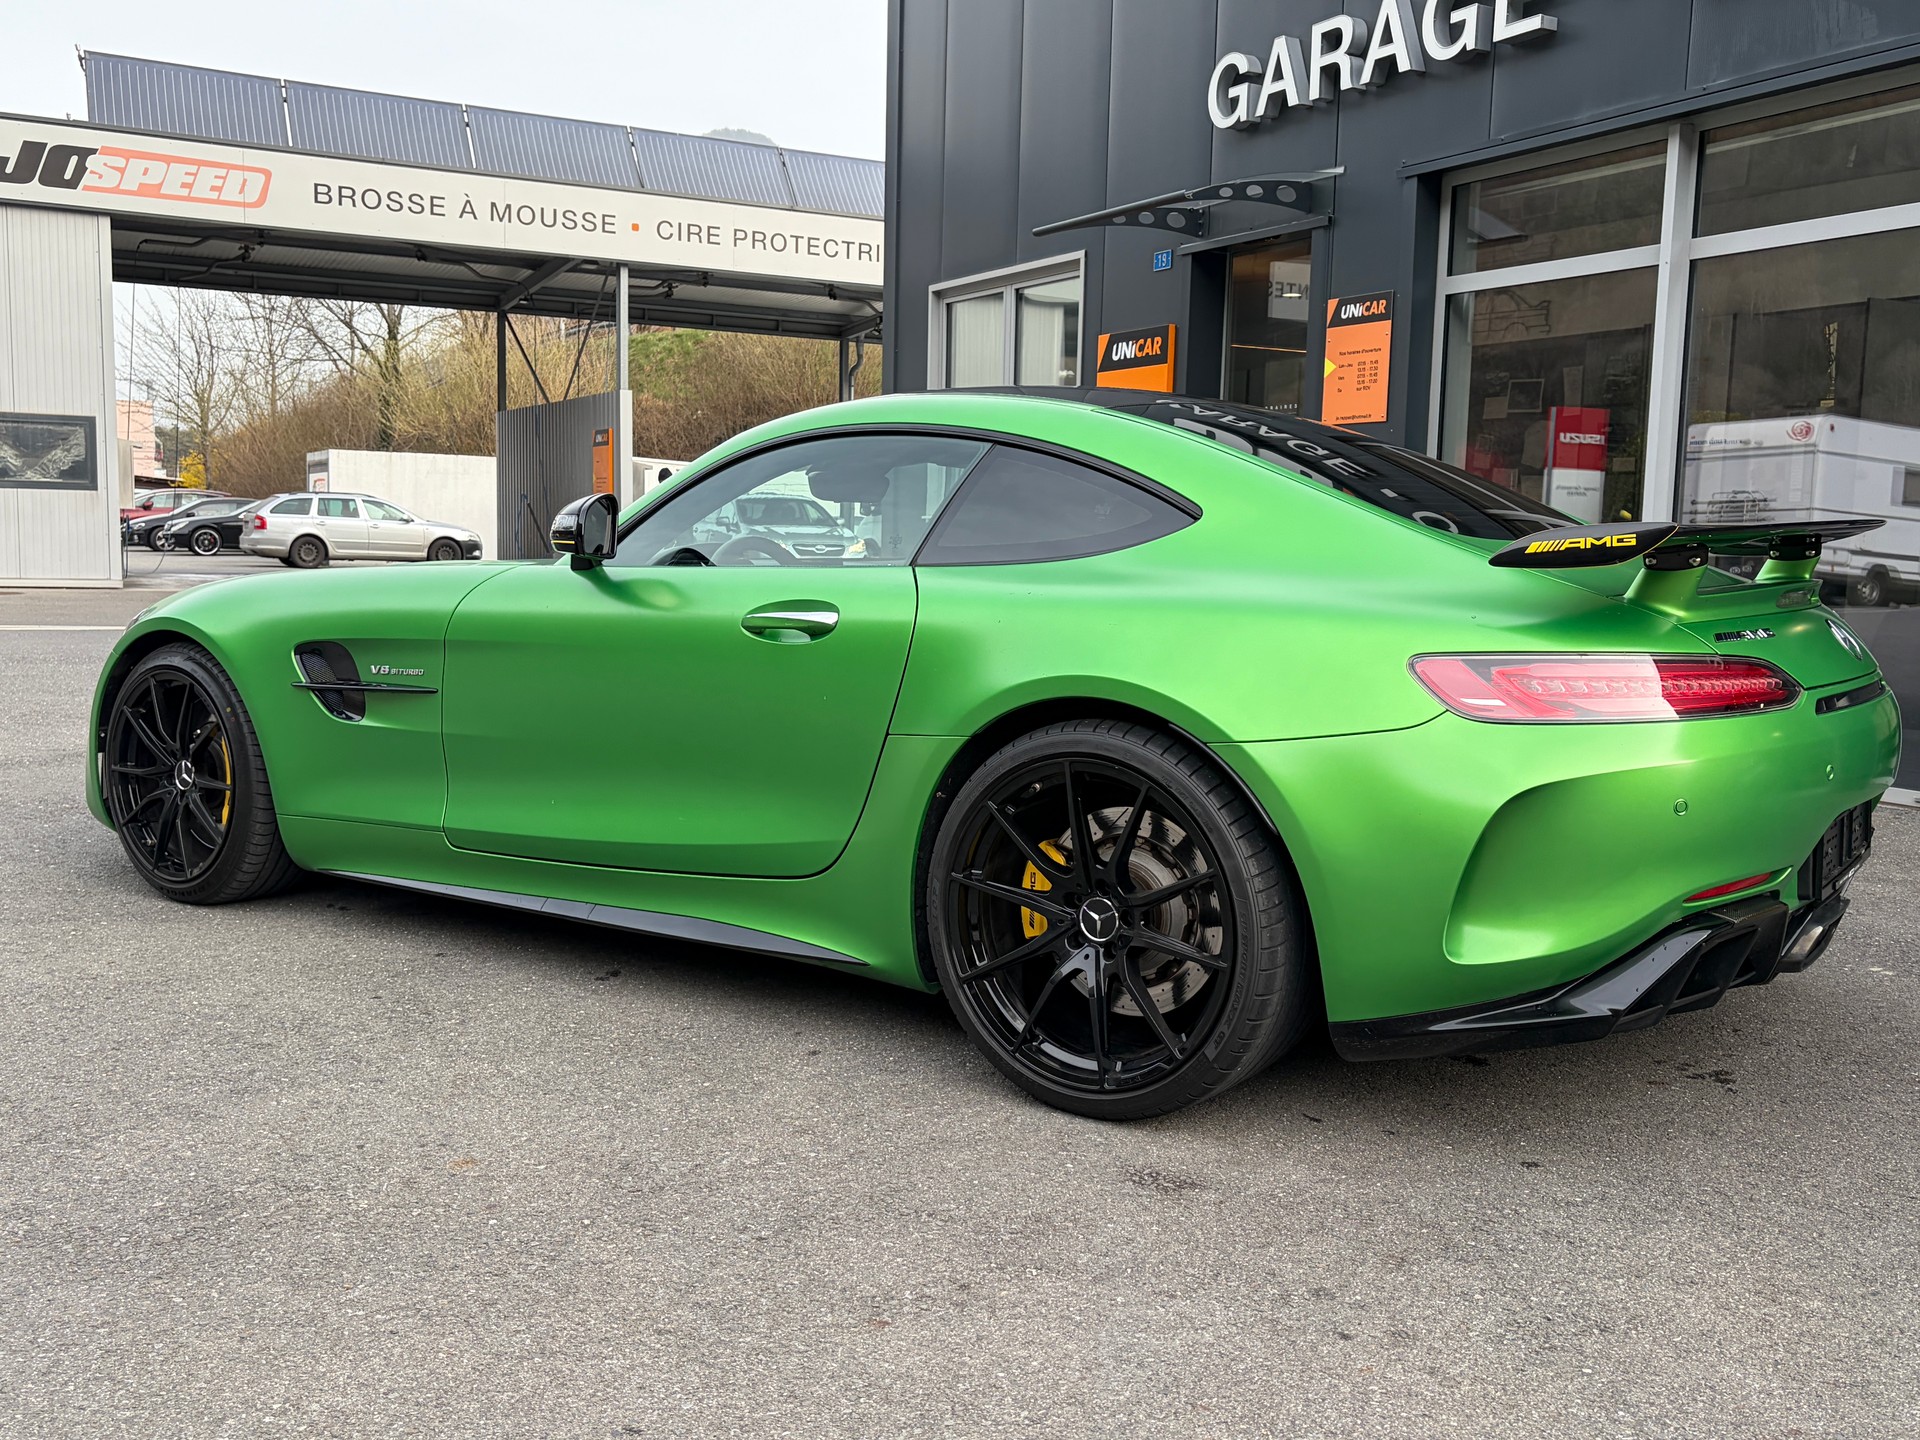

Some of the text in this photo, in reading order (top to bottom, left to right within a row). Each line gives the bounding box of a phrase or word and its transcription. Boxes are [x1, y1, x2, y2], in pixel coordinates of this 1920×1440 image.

[313, 182, 881, 263] BROSSE À MOUSSE CIRE PROTECTRI
[1158, 254, 1168, 268] 19
[370, 664, 424, 676] V8 BITURBO
